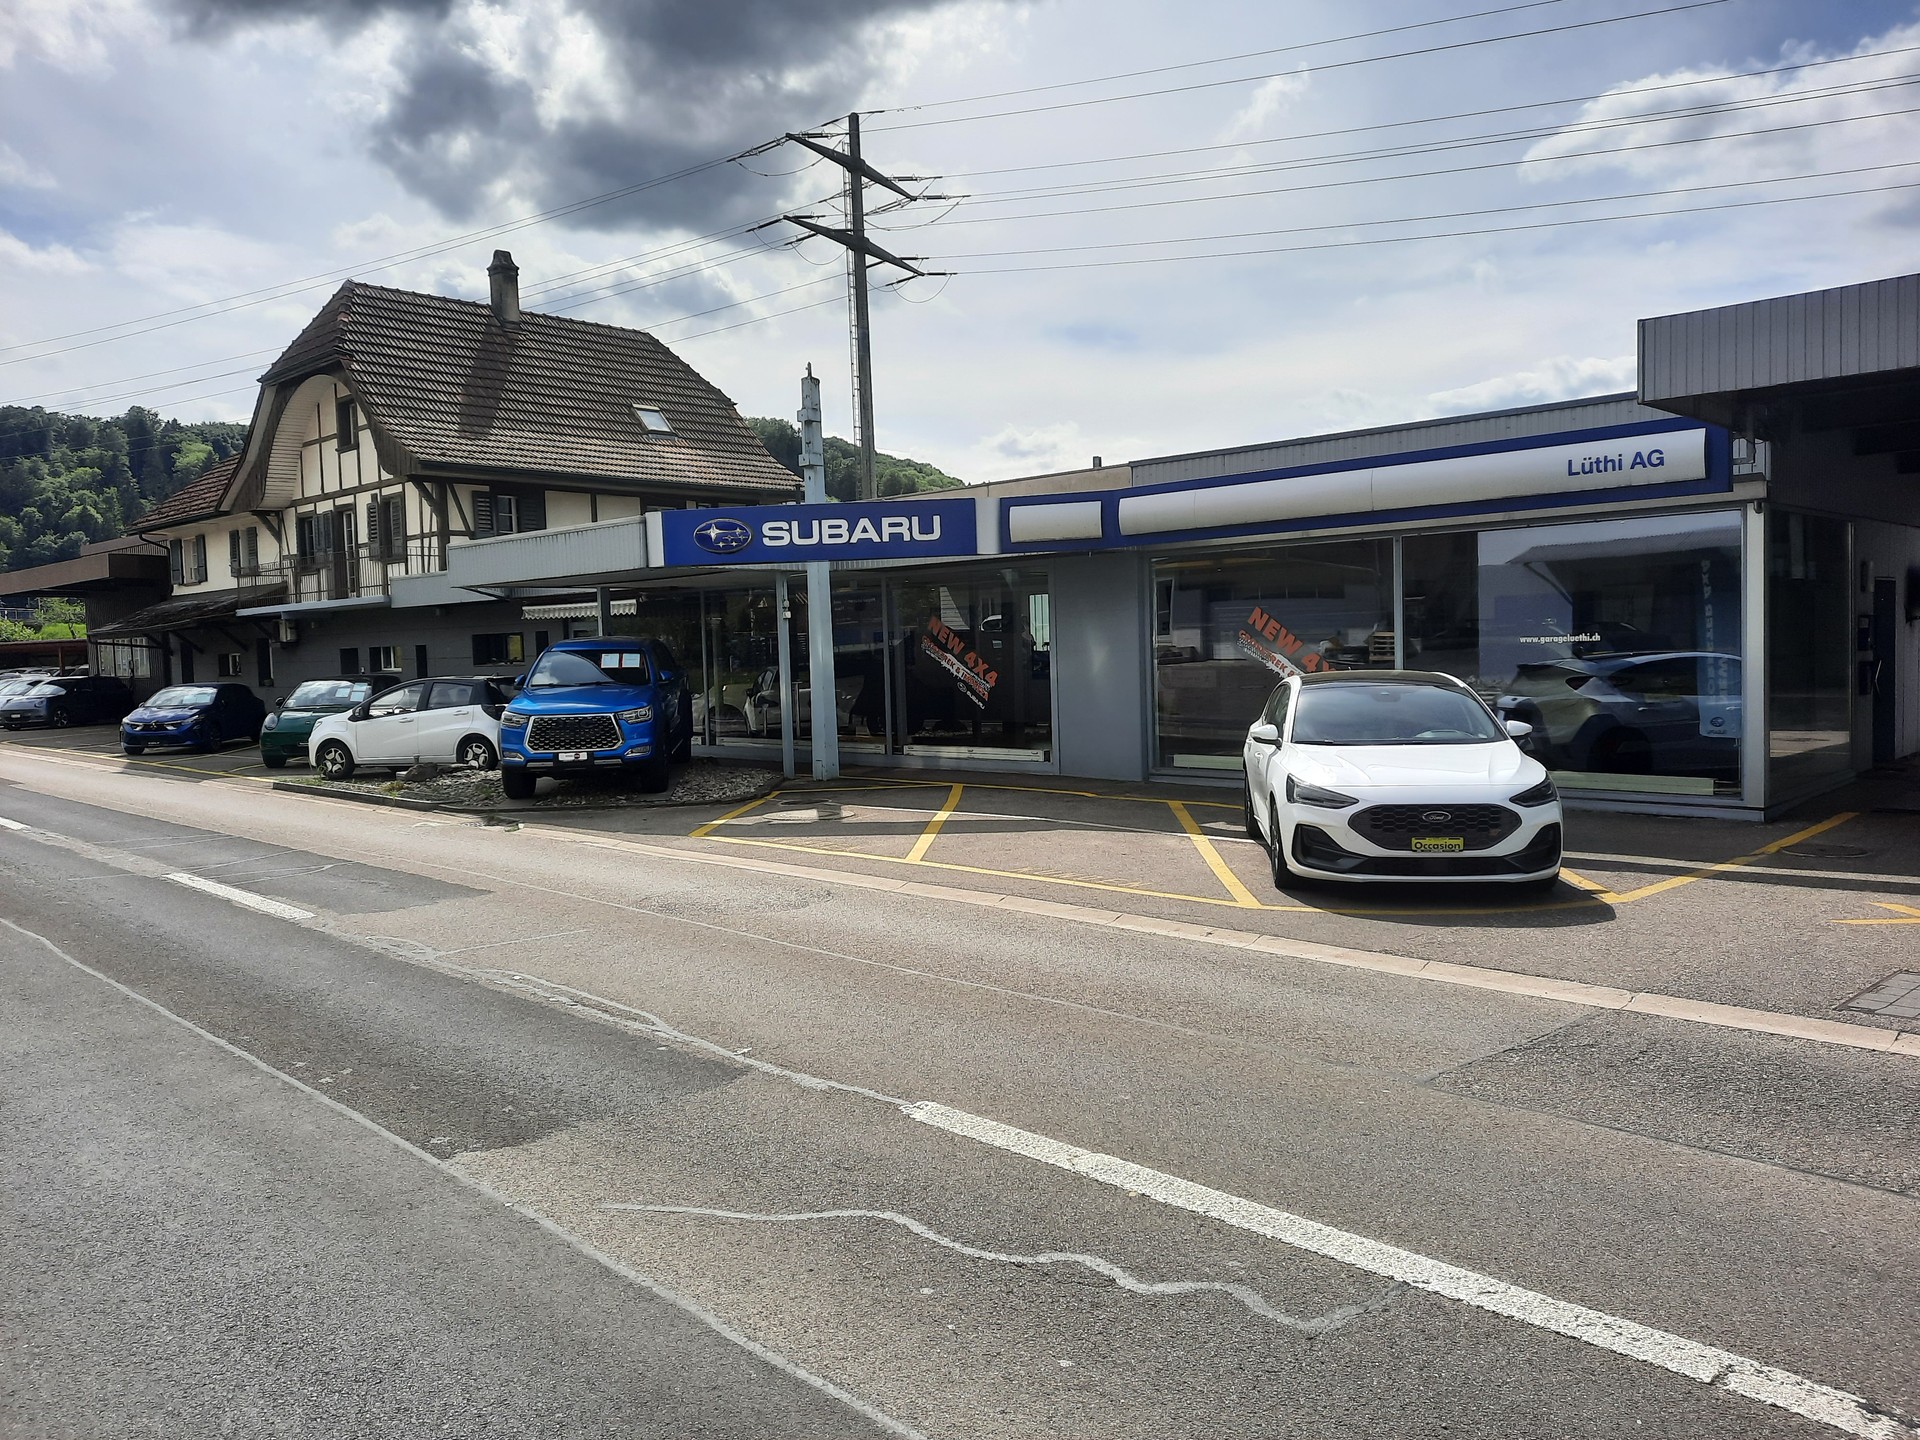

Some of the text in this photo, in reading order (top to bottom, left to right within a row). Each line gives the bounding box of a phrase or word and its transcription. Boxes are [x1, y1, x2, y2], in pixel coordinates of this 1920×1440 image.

[1568, 449, 1665, 476] Lüthi AG
[762, 515, 941, 546] SUBARU
[1247, 606, 1304, 656] NEW
[1519, 632, 1601, 645] www.garageluethi.ch
[927, 616, 998, 687] NEW 4X4
[1414, 841, 1461, 850] Occasion
